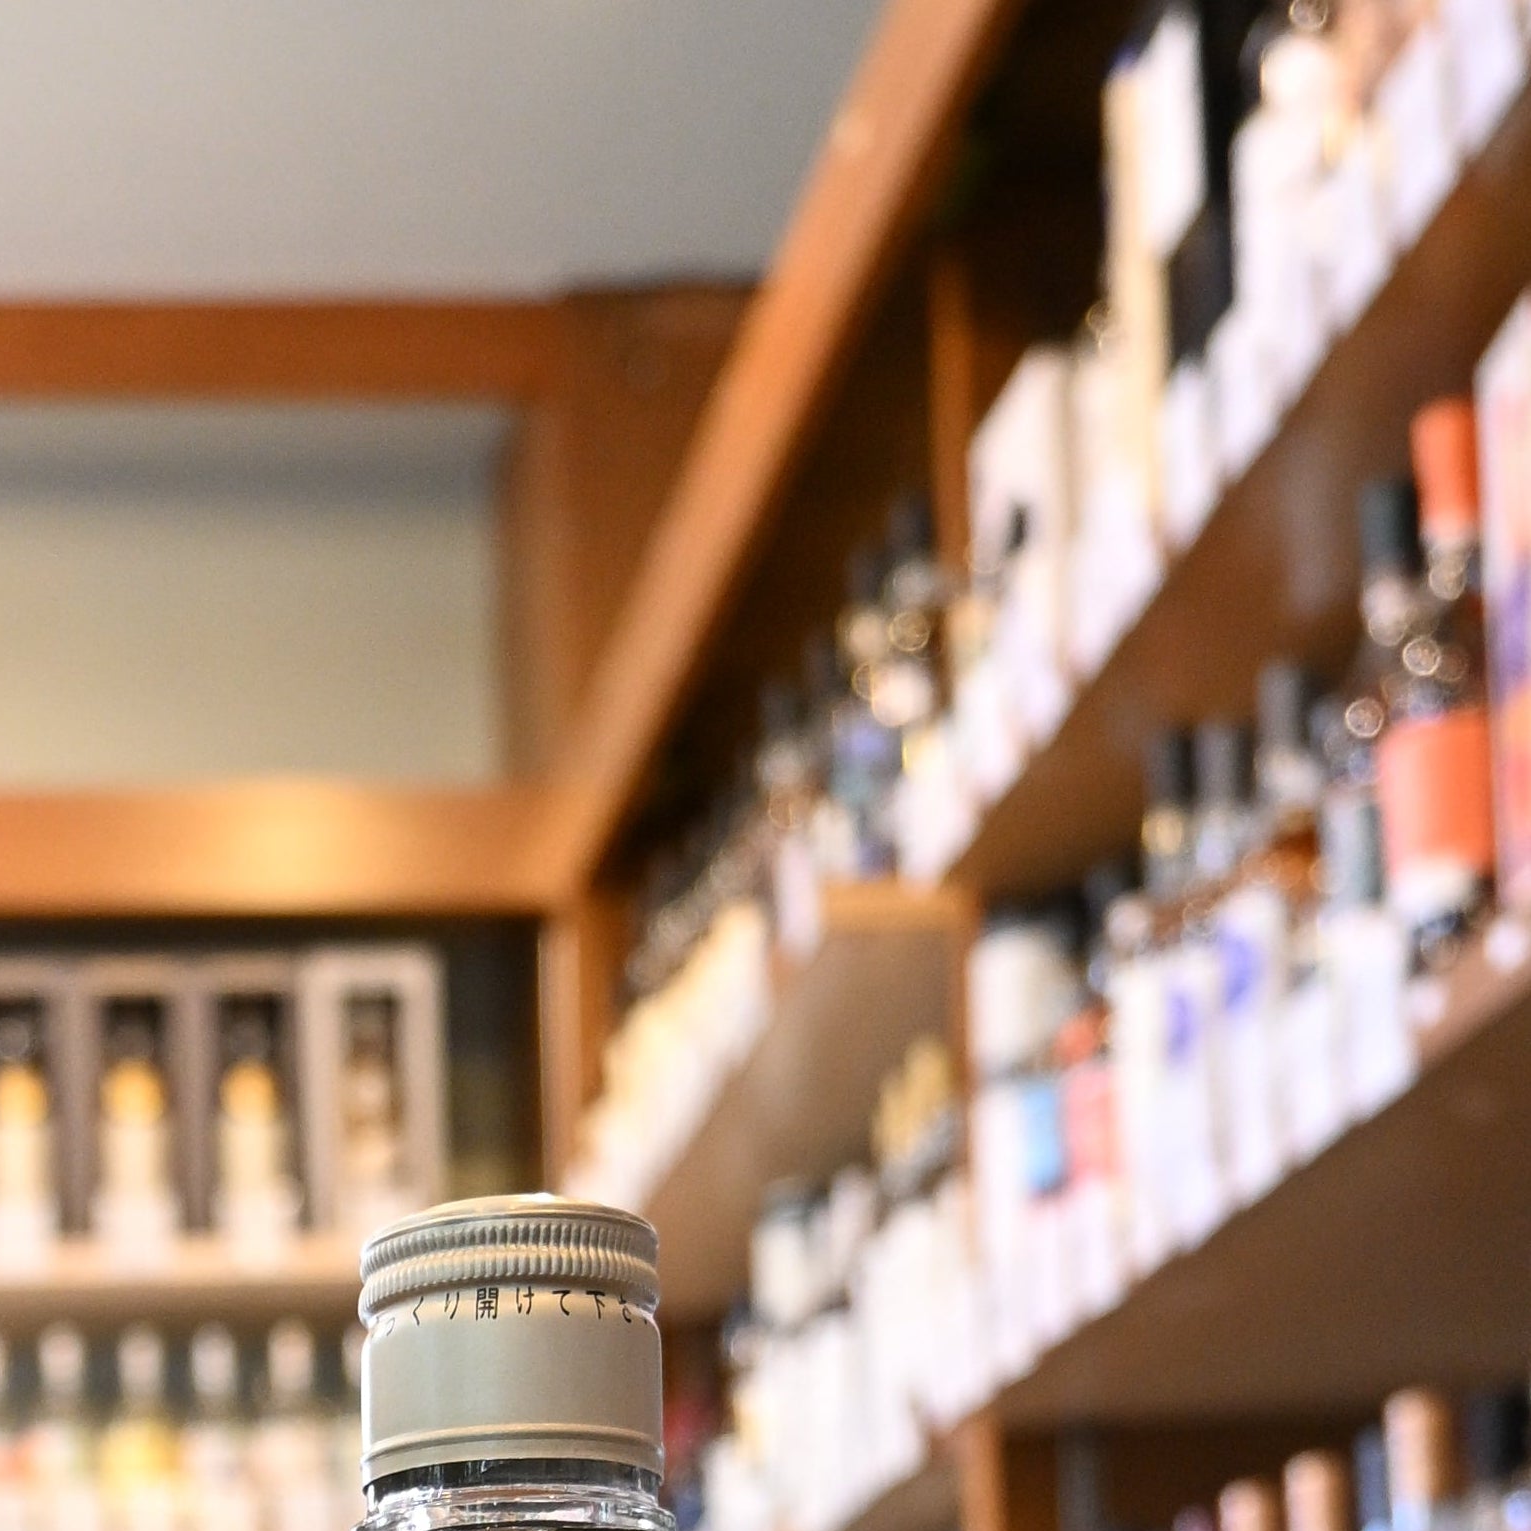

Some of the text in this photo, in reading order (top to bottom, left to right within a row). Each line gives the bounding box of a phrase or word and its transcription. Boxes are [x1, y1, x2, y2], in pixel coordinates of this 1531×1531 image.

[372, 1285, 650, 1336] っくり開けて下さ
